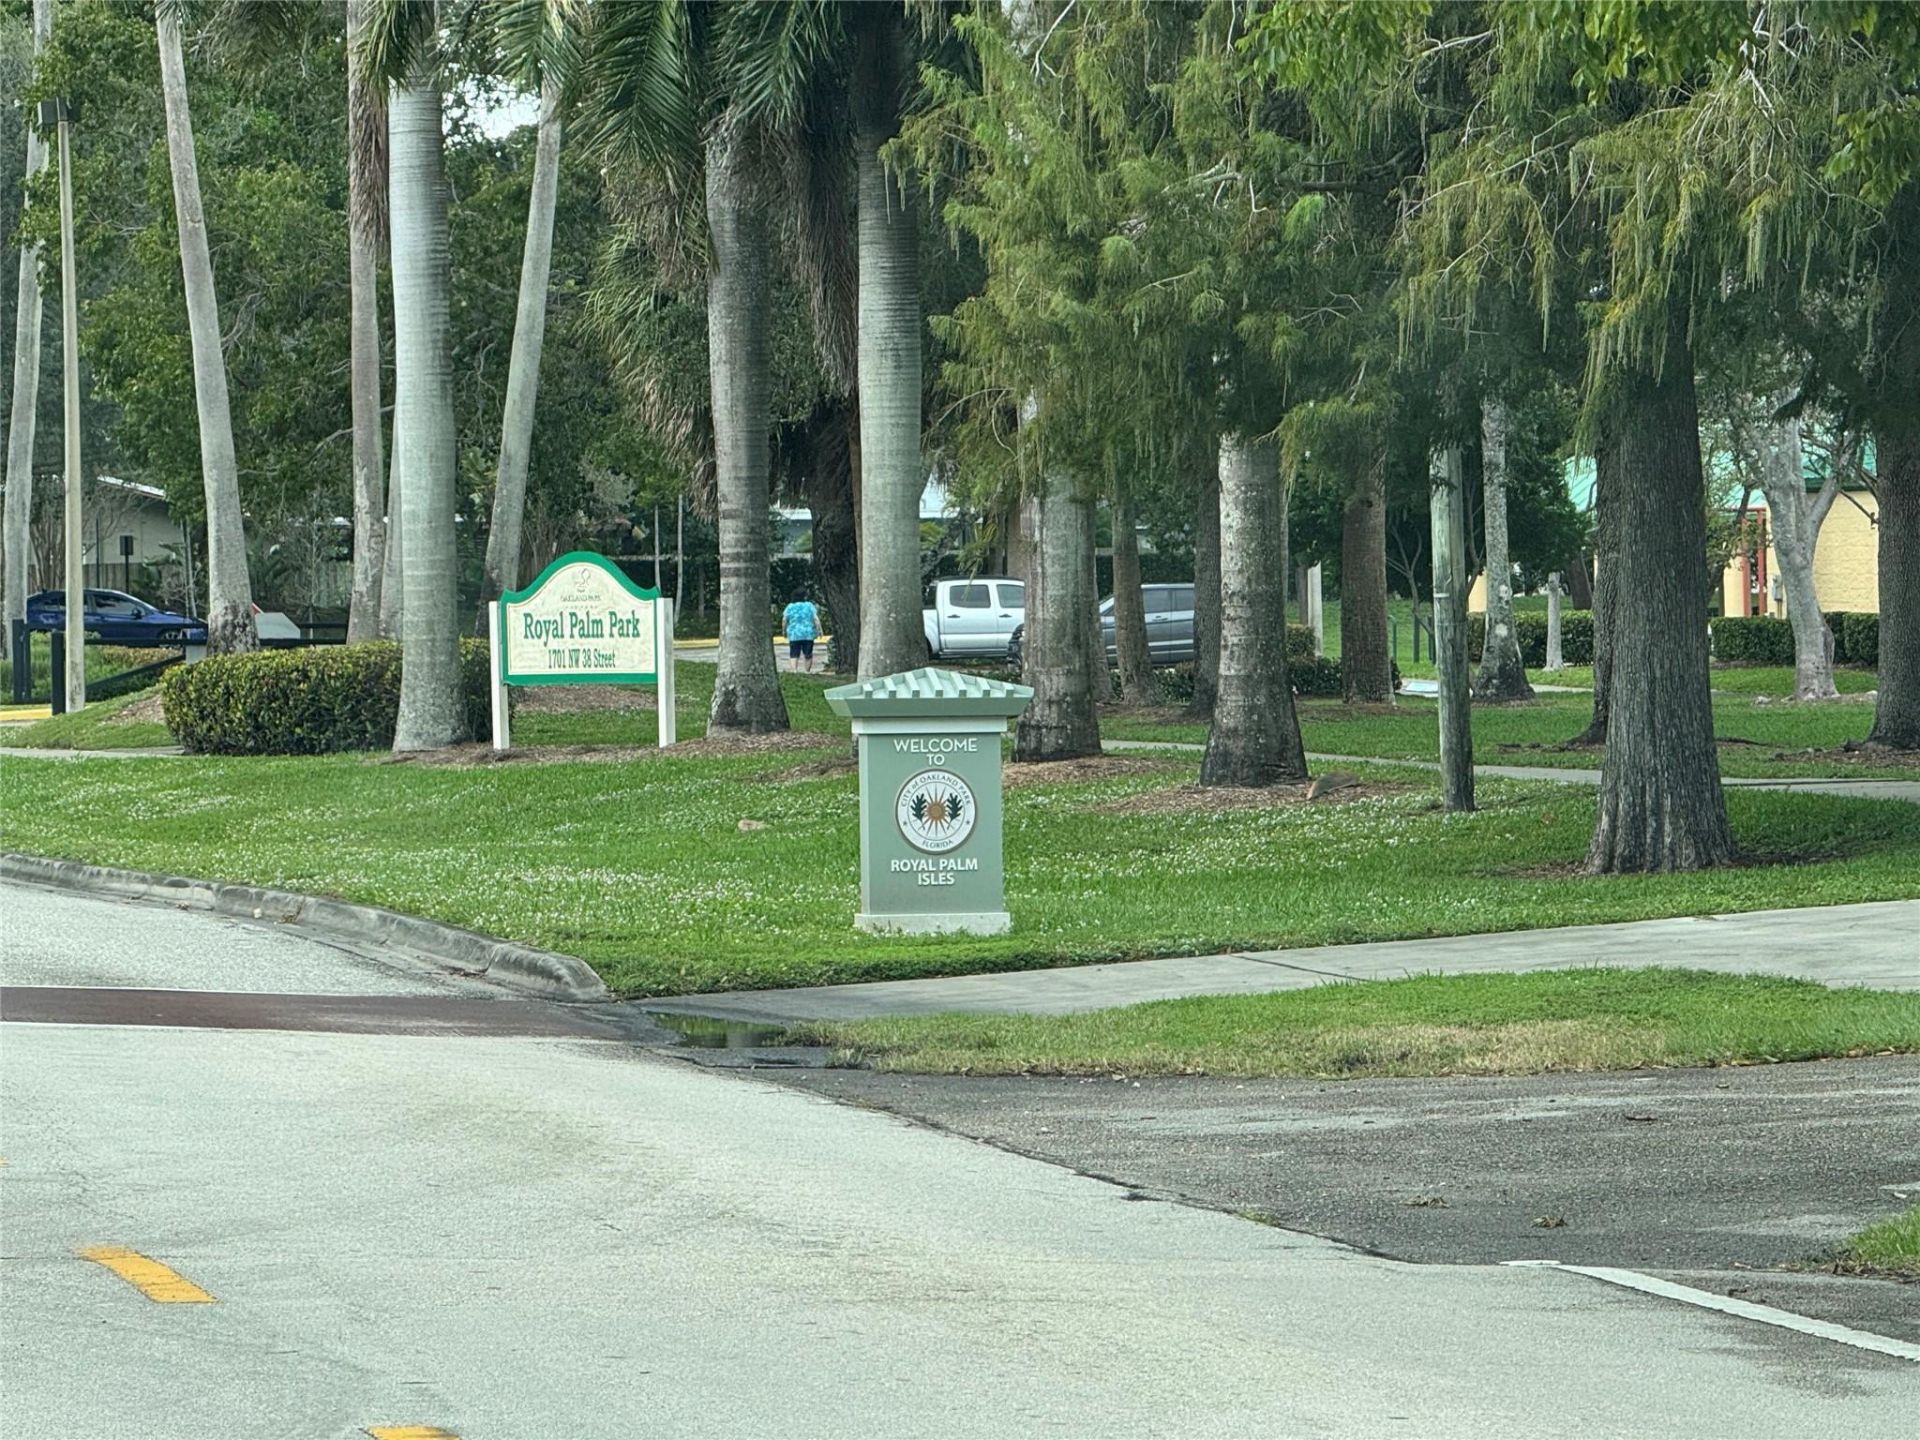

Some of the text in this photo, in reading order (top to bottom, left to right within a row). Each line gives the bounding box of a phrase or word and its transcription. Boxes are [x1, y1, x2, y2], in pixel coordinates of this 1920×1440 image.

[523, 610, 641, 646] Royal Palm Park
[548, 648, 616, 669] 1701 NW 38 Street
[894, 738, 978, 753] WELCOME
[926, 754, 945, 766] TO
[901, 774, 971, 807] CITY of OAKLAND PARK
[922, 840, 954, 849] FLORIDA
[891, 858, 978, 871] ROYAL PALM
[918, 873, 955, 886] ISLES
